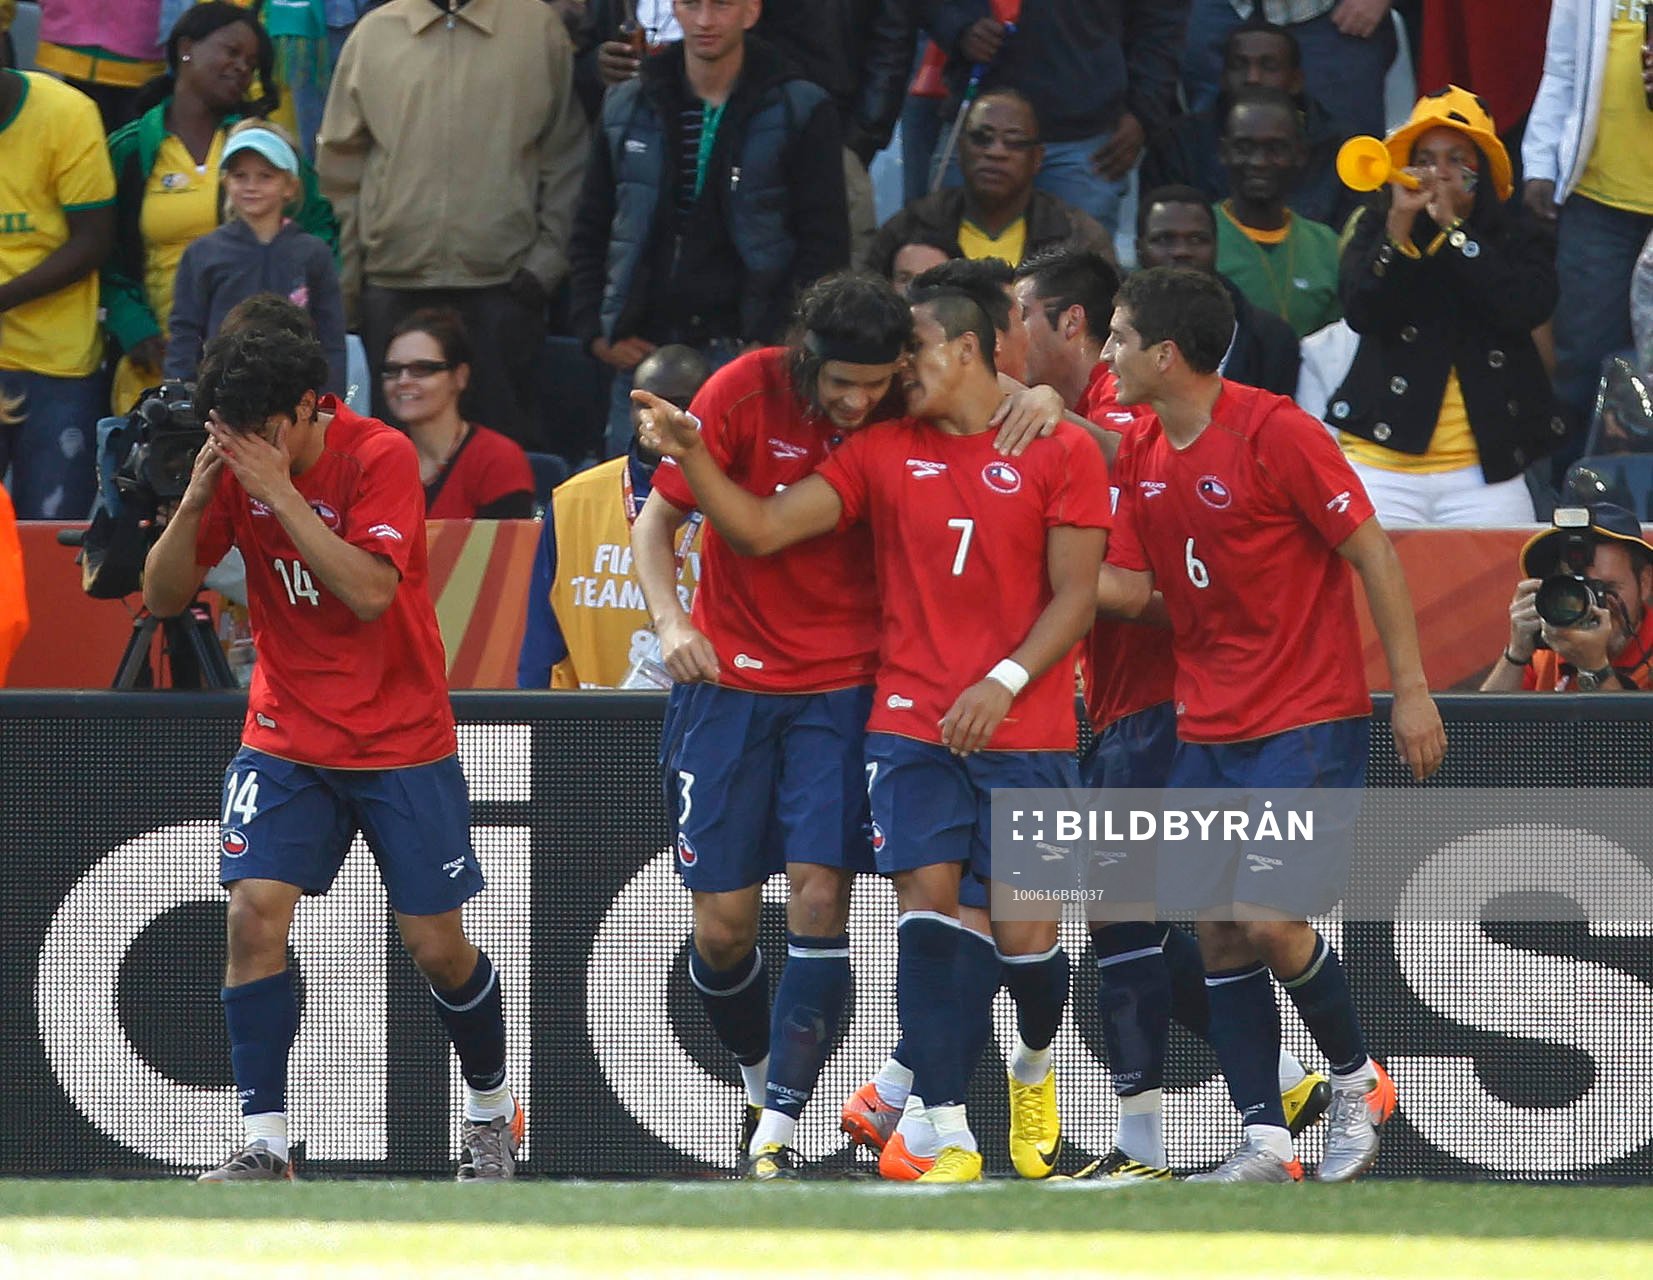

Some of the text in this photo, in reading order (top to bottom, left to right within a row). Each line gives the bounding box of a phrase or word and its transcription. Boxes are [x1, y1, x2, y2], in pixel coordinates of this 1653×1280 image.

[594, 543, 633, 575] FIF
[947, 518, 974, 577] 7
[1185, 537, 1210, 589] 6
[274, 558, 319, 606] 14
[571, 576, 648, 610] TEAM
[222, 770, 259, 824] 14
[678, 770, 695, 825] 3
[766, 1081, 808, 1100] BROOKS
